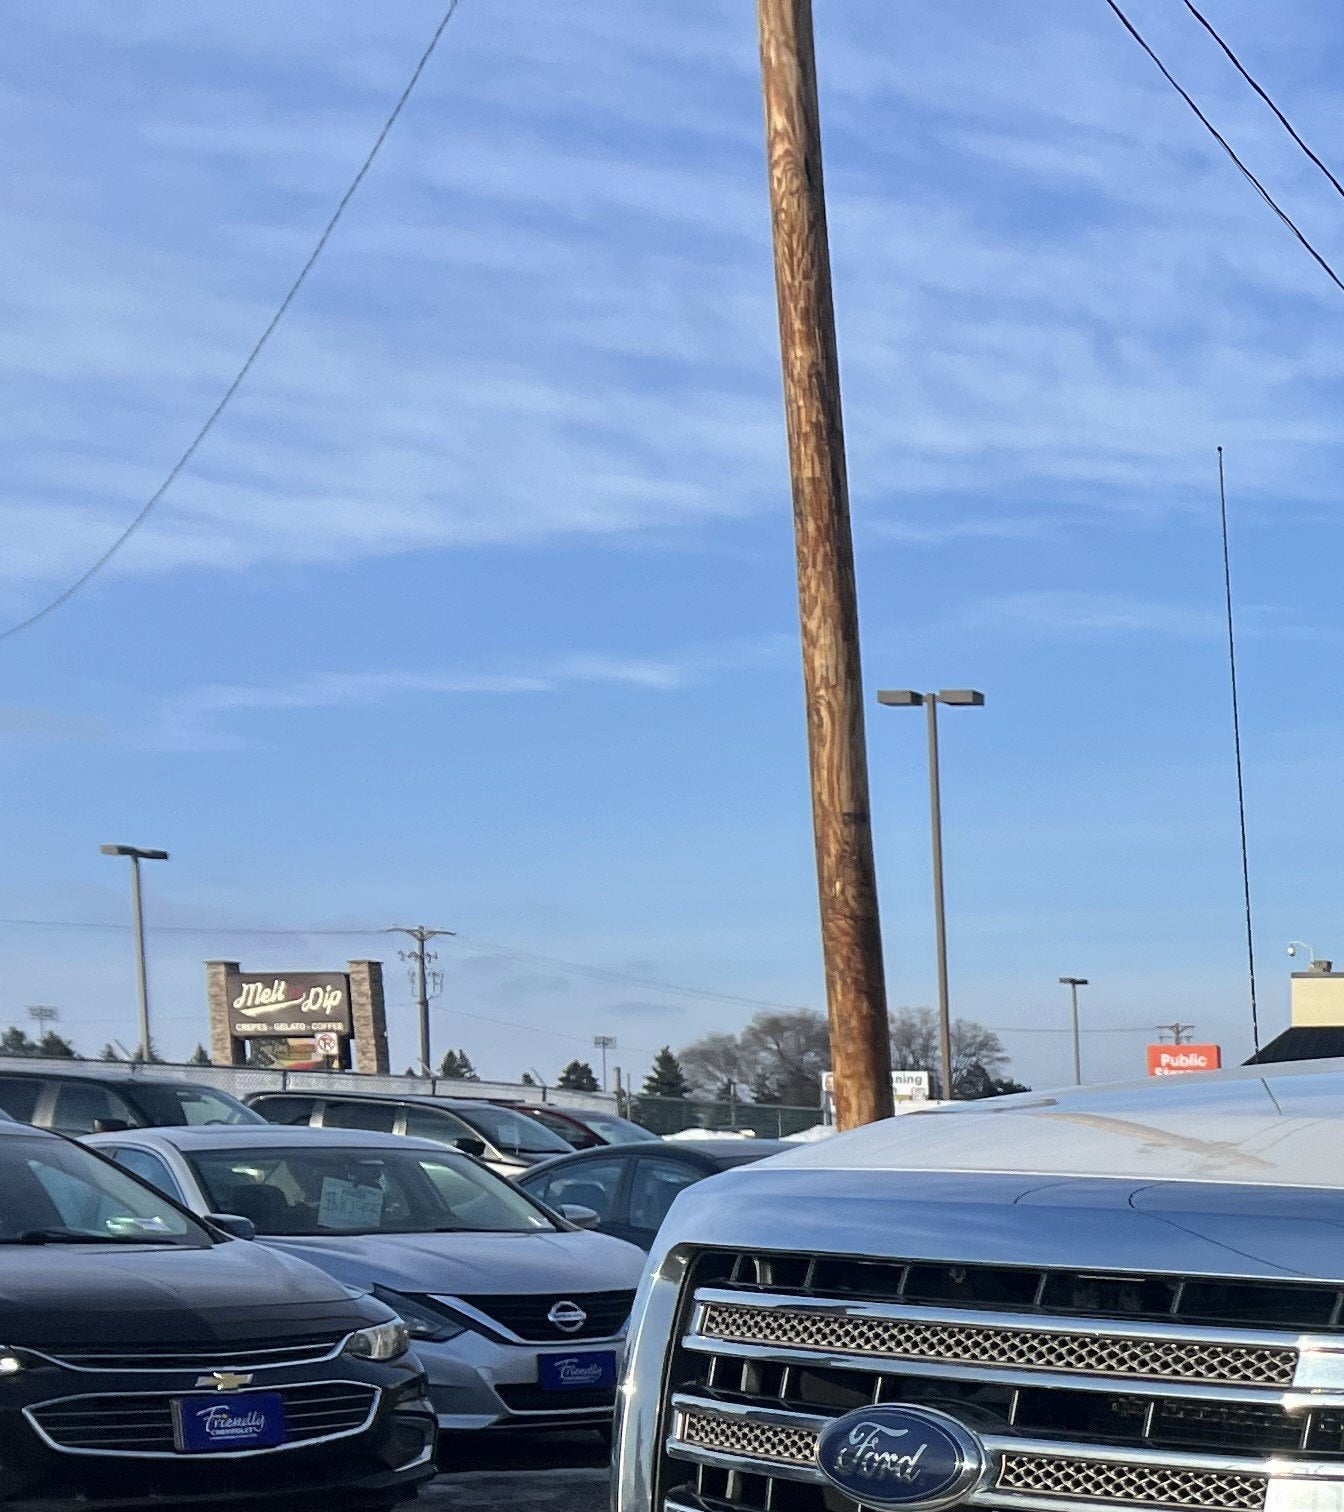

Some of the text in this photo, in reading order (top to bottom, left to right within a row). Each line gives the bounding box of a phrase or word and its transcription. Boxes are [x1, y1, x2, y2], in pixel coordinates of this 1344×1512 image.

[233, 979, 342, 1015] Melt Dip
[1160, 1053, 1207, 1067] Public
[196, 1405, 266, 1432] Friendly
[834, 1421, 928, 1483] Ford
